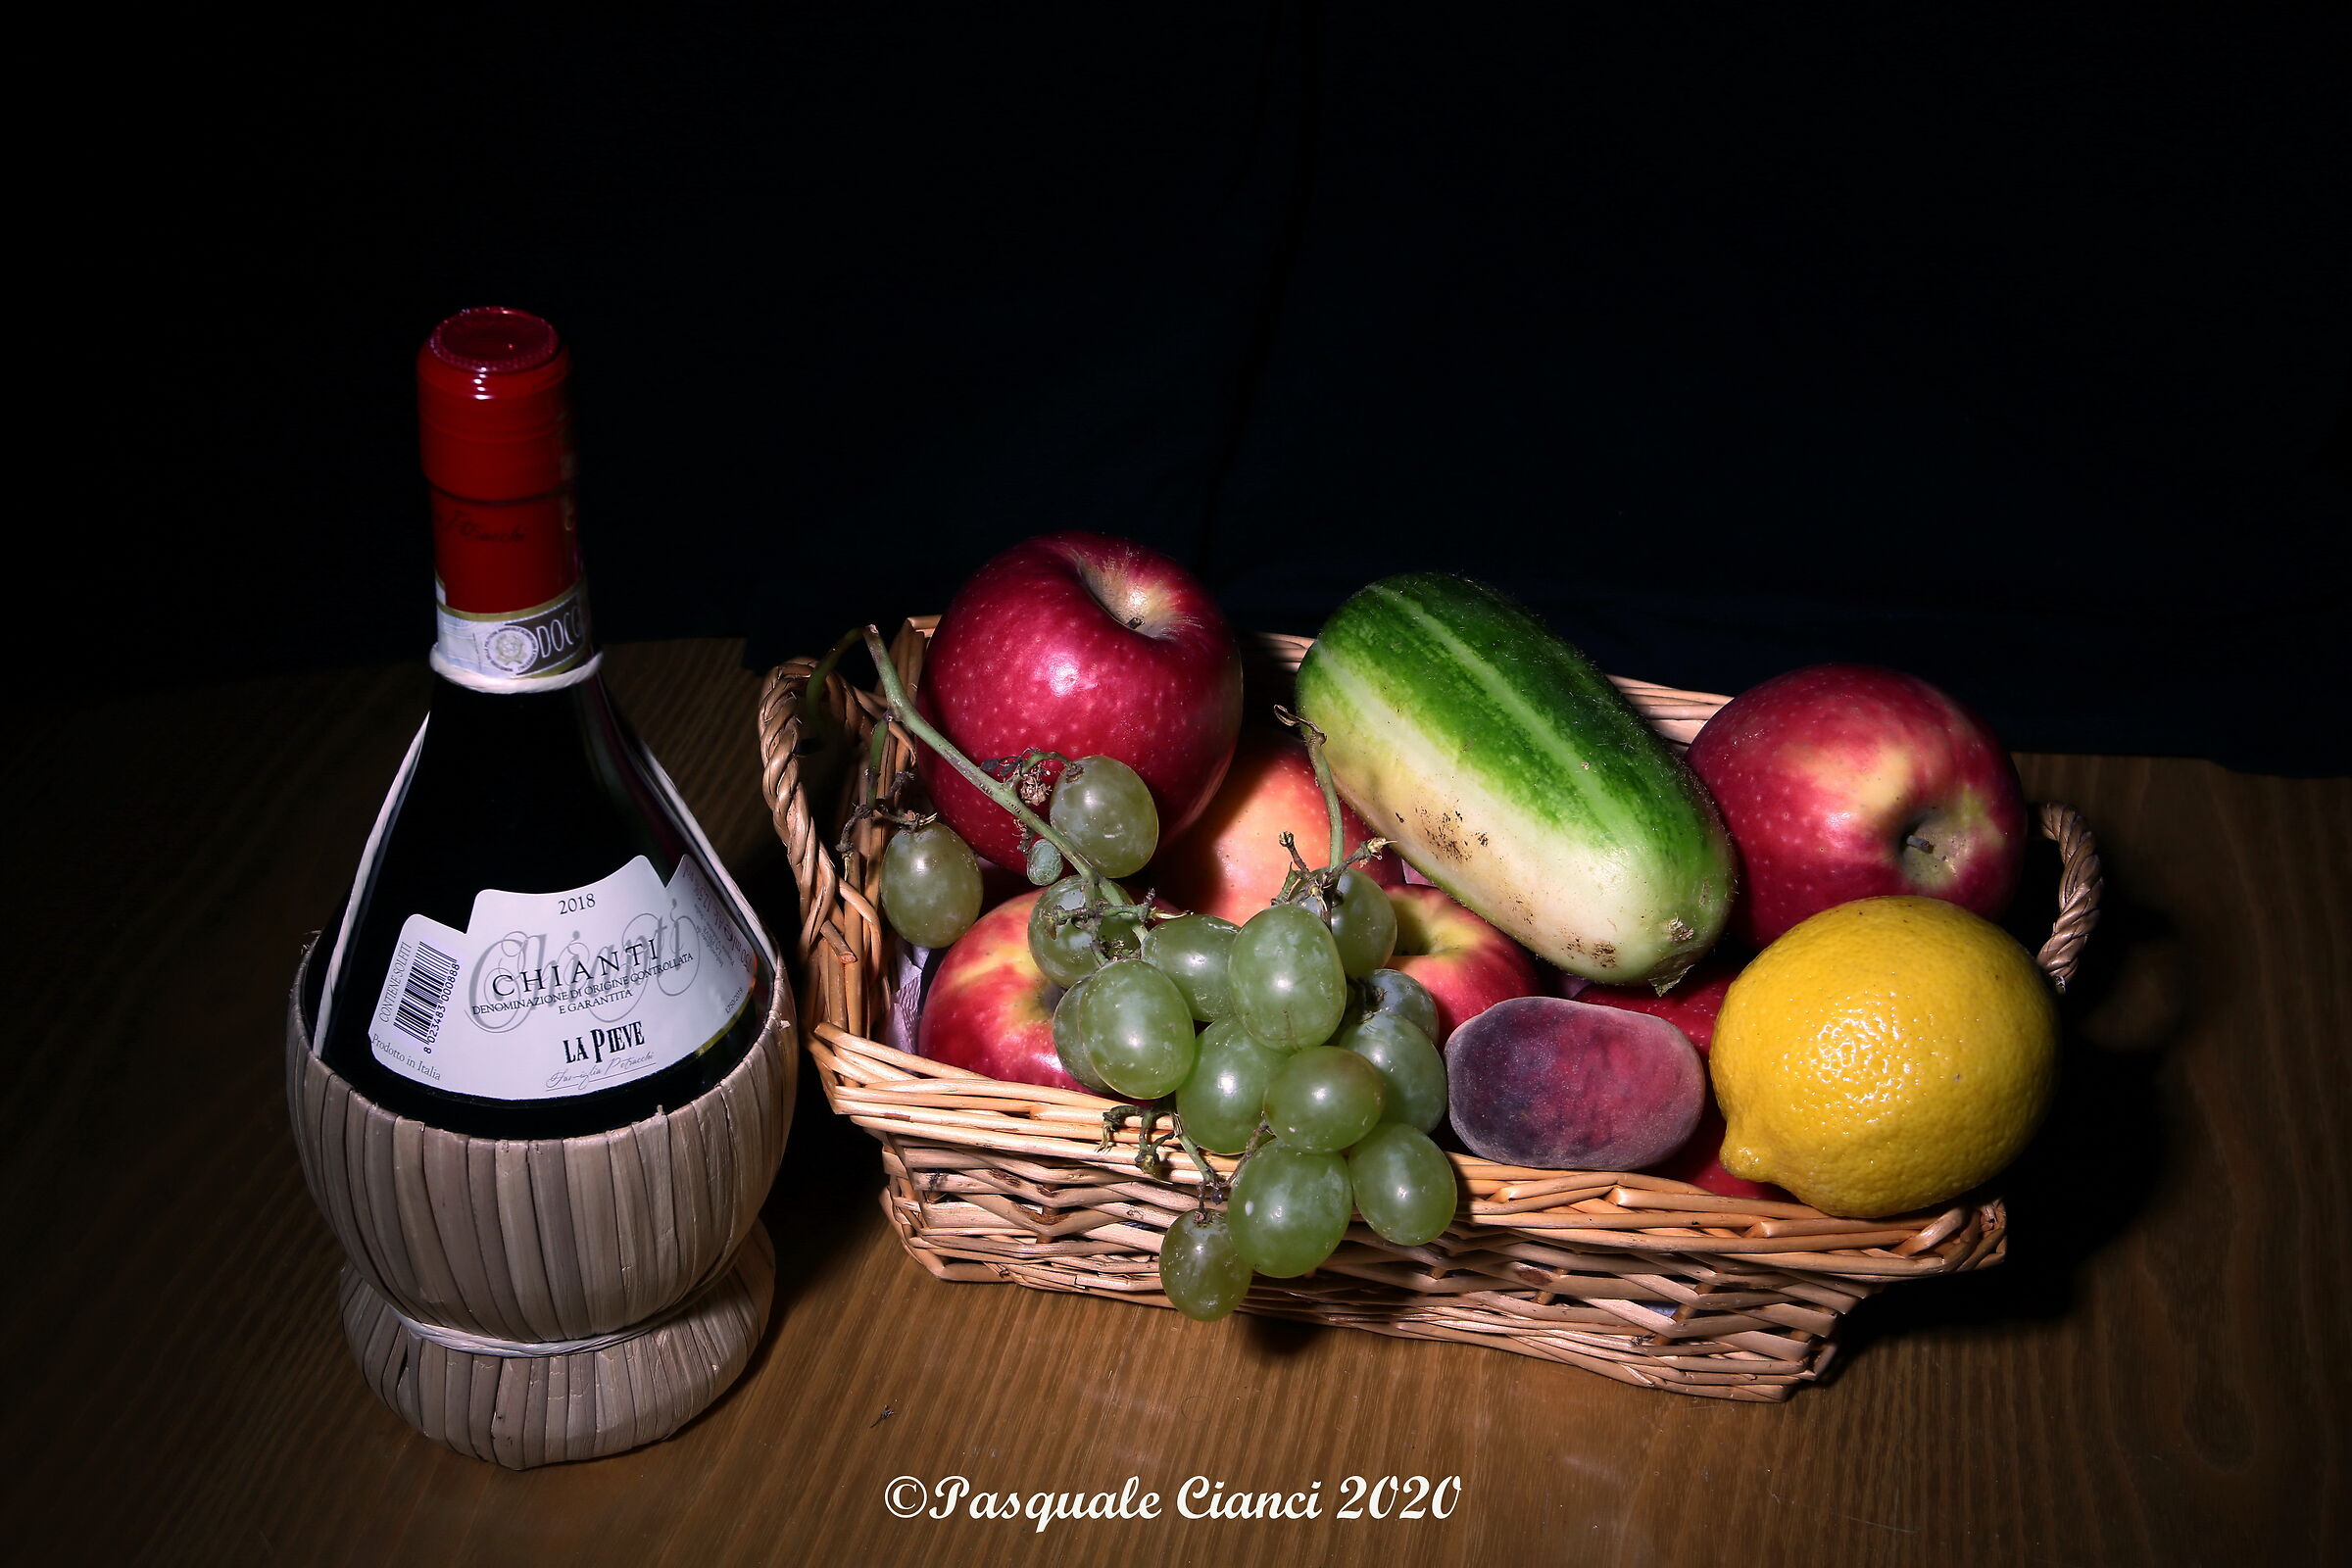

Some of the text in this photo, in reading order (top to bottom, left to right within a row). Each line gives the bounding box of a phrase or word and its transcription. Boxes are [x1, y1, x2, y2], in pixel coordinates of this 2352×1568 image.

[559, 893, 596, 915] 2018
[472, 953, 694, 1015] DENOMINAZIONE DI ORIGINE CONTROLLATA
[492, 939, 659, 997] CHIANTI
[379, 976, 402, 1023] CONTIENE
[423, 962, 461, 1054] 8 023483 000888
[559, 989, 633, 1015] E GARANTITA
[371, 1033, 441, 1081] Prodotto in Italia
[563, 1021, 645, 1064] LA PIEVE
